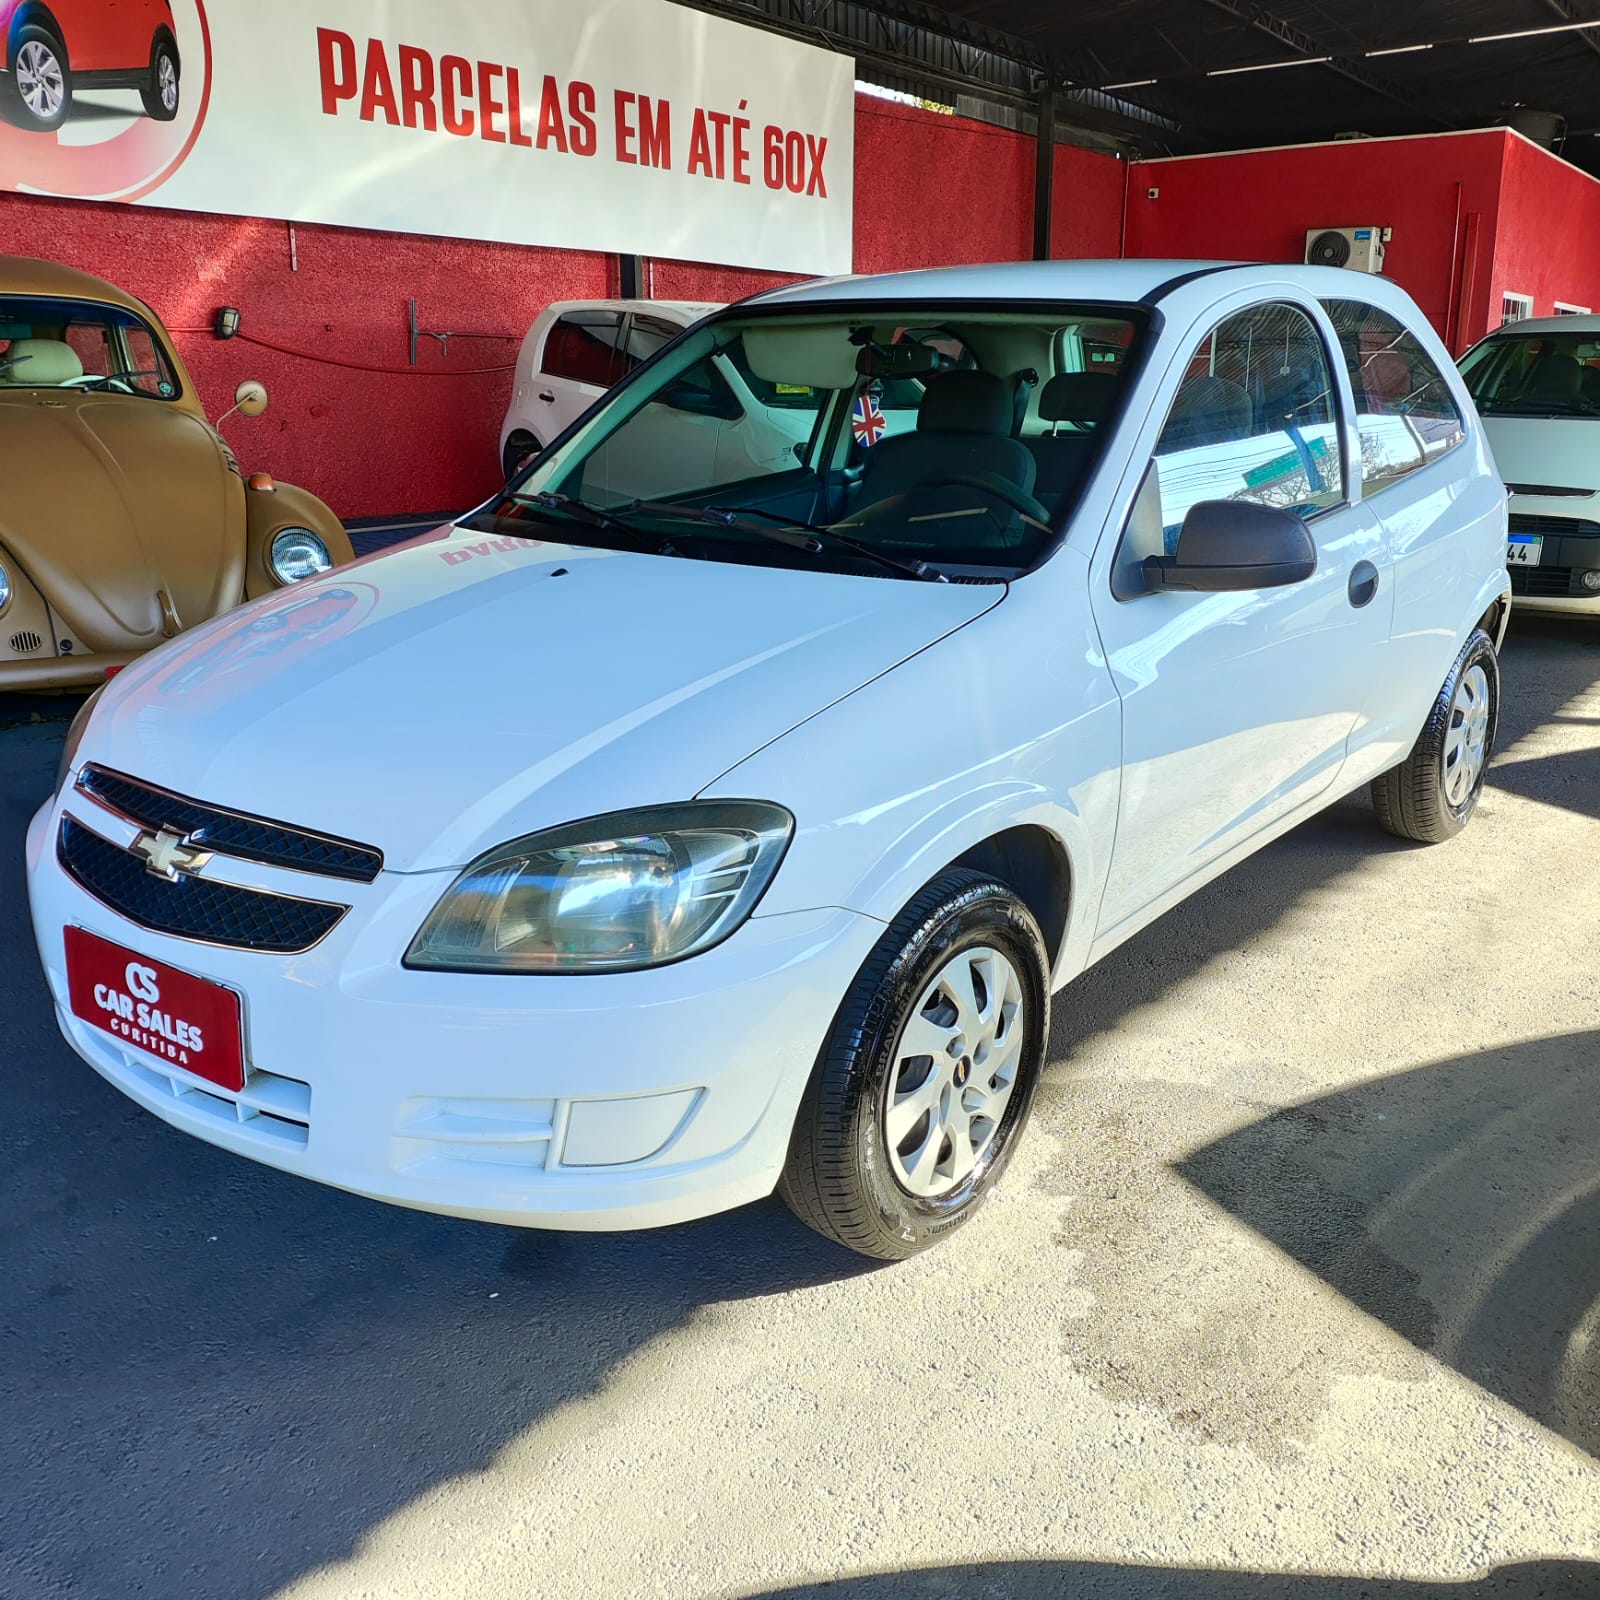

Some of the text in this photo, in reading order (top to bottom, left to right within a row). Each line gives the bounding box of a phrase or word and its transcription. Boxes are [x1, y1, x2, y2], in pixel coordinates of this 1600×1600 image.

[316, 26, 828, 198] PARCELAS EM ATÉ 60X
[125, 962, 160, 1004] CS
[94, 984, 203, 1052] CAR SALES
[110, 1018, 188, 1064] CURITIBA
